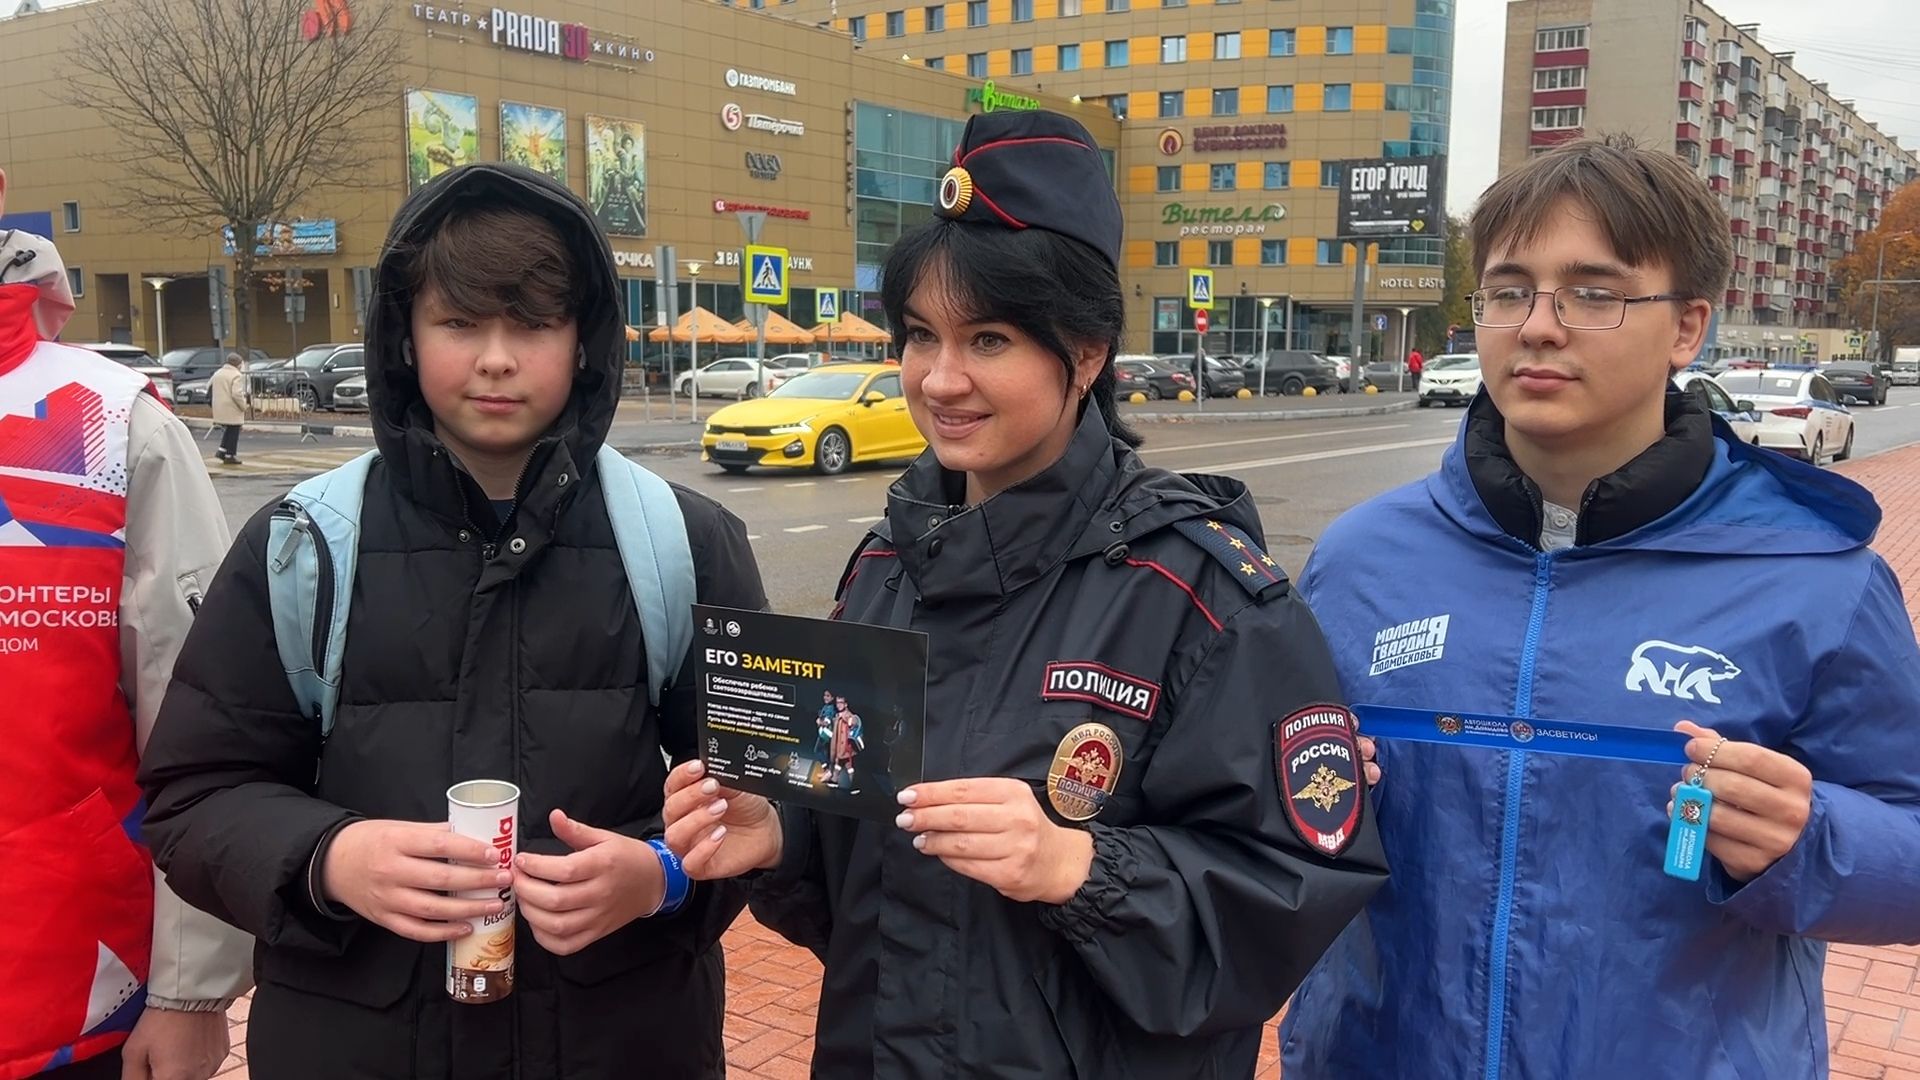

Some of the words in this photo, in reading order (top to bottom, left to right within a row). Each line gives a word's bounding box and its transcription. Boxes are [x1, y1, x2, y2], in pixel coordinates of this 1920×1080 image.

[413, 3, 471, 27] ТЕАТР
[492, 7, 560, 55] PRADA
[605, 41, 655, 63] КИНО
[739, 73, 796, 95] ГАЗПРОМБАНК
[1351, 166, 1387, 192] ЕГОР
[1390, 165, 1428, 191] КРИД
[1180, 224, 1266, 237] ресторан
[1380, 277, 1415, 289] HOTEL
[1374, 614, 1450, 646] МОЛОДАЯ
[705, 648, 738, 667] ЕГО
[742, 653, 825, 679] ЗАМЕТЯТ
[1373, 648, 1439, 674] ПОДМОСКОВЬЕ
[1050, 670, 1151, 710] ПОЛИЦИЯ
[1285, 712, 1345, 739] ПОЛИЦИЯ
[1536, 728, 1599, 742] ЗАСВЕТИСЬ!
[1291, 742, 1350, 773] РОССИЯ
[1059, 779, 1105, 801] ПОЛИЦИЯ
[1317, 827, 1345, 850] МВД
[492, 815, 514, 904] ntella
